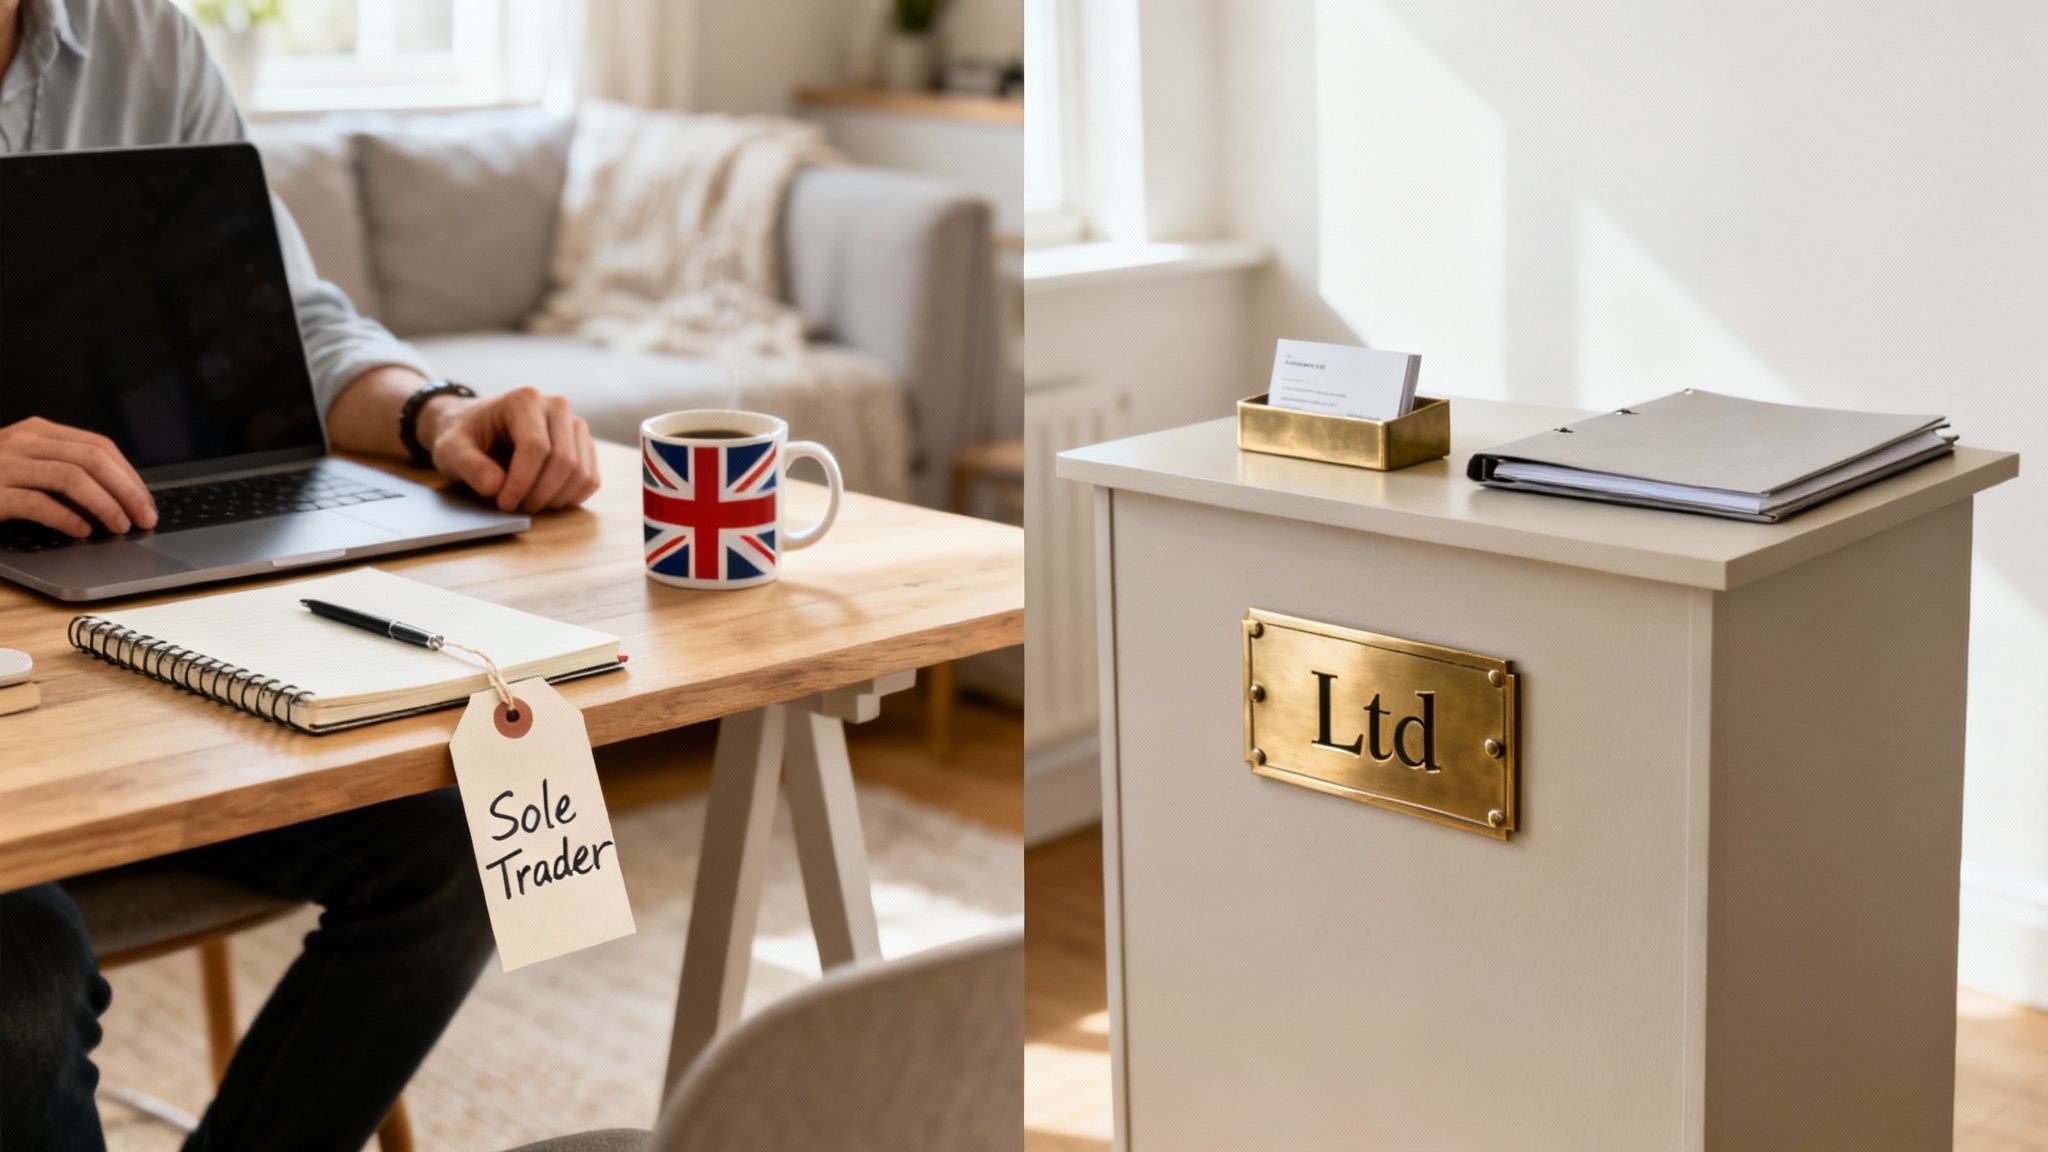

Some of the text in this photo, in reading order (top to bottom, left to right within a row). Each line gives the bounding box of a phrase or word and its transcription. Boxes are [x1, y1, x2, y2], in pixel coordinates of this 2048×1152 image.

[1311, 670, 1442, 772] Ltd
[489, 778, 577, 841] Sole
[485, 836, 614, 900] Trader
